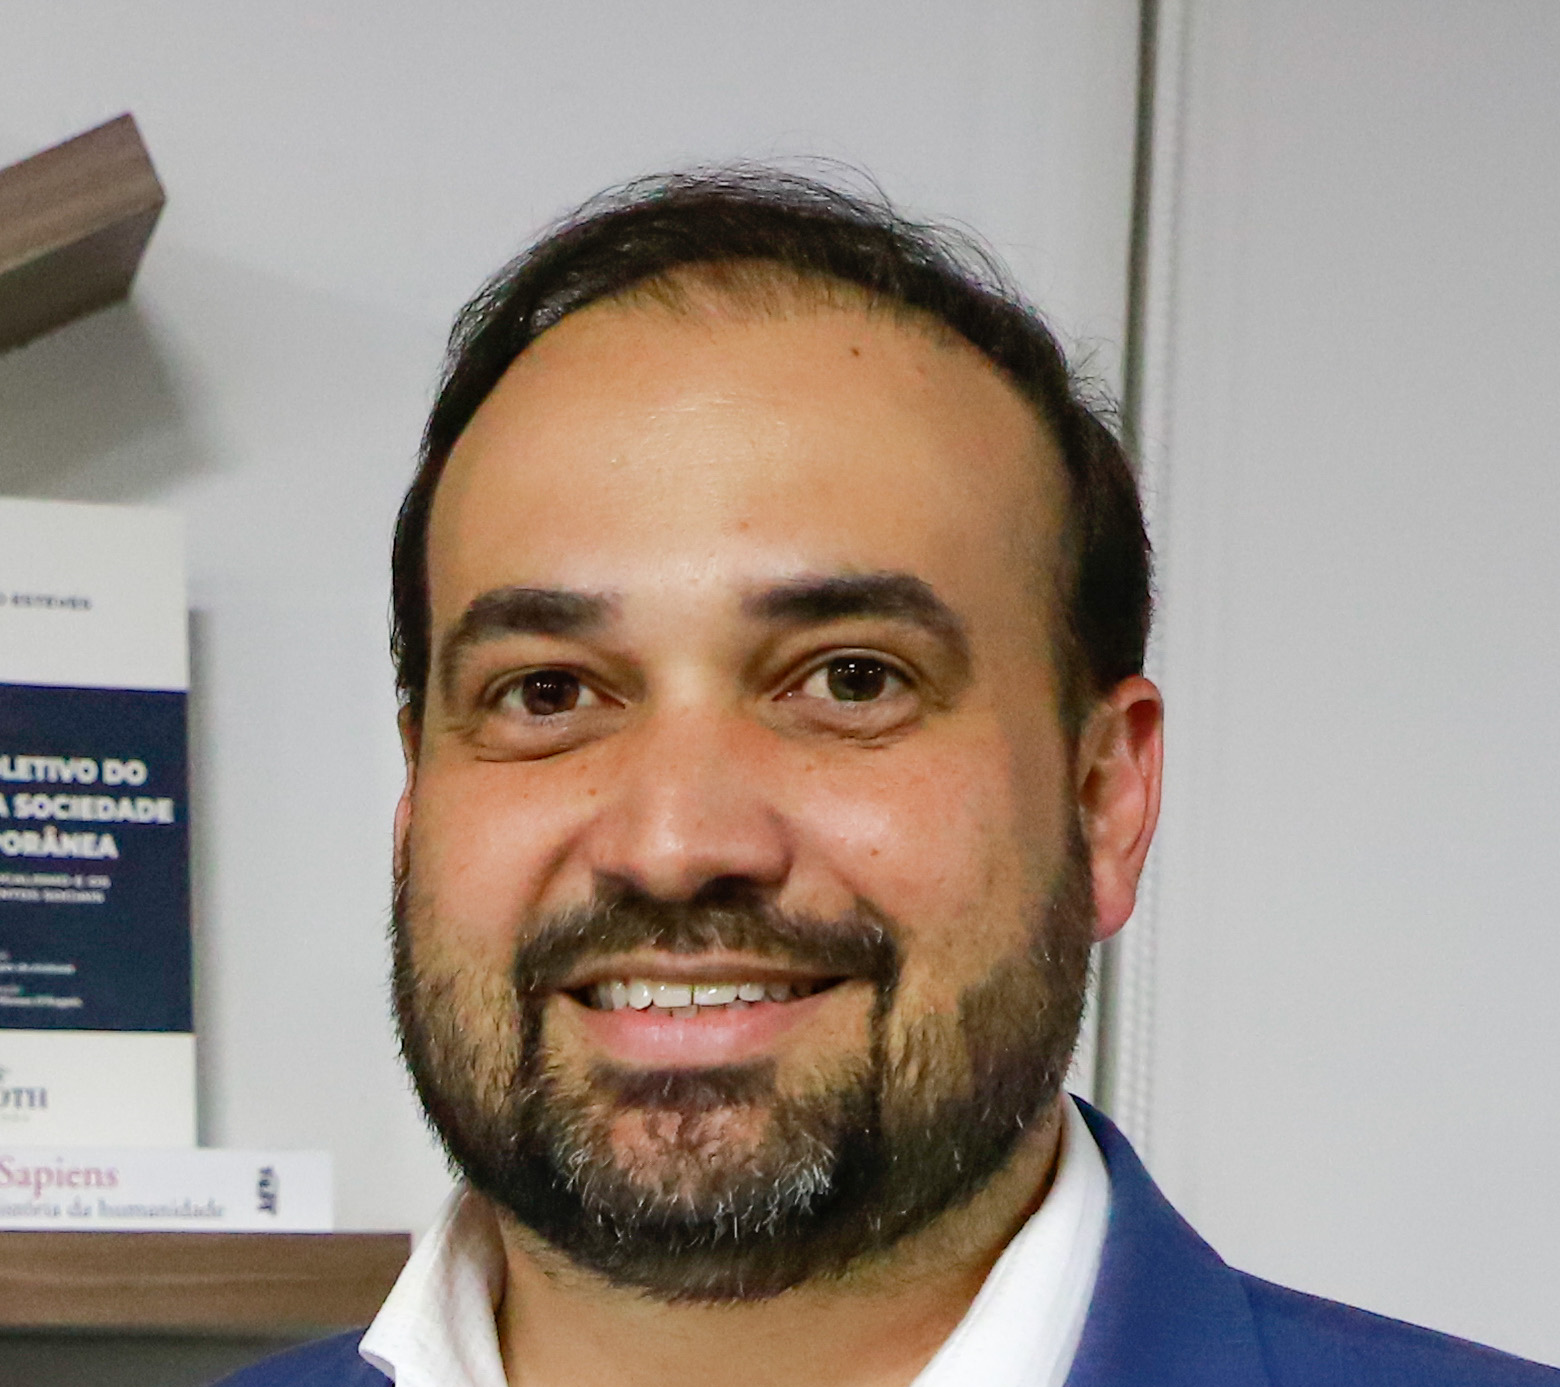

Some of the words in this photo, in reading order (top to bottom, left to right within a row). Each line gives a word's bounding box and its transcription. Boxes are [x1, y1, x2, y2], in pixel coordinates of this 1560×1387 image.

[102, 758, 149, 787] DO
[13, 792, 175, 825] SOCIEDADE
[97, 1195, 226, 1219] humanidade
